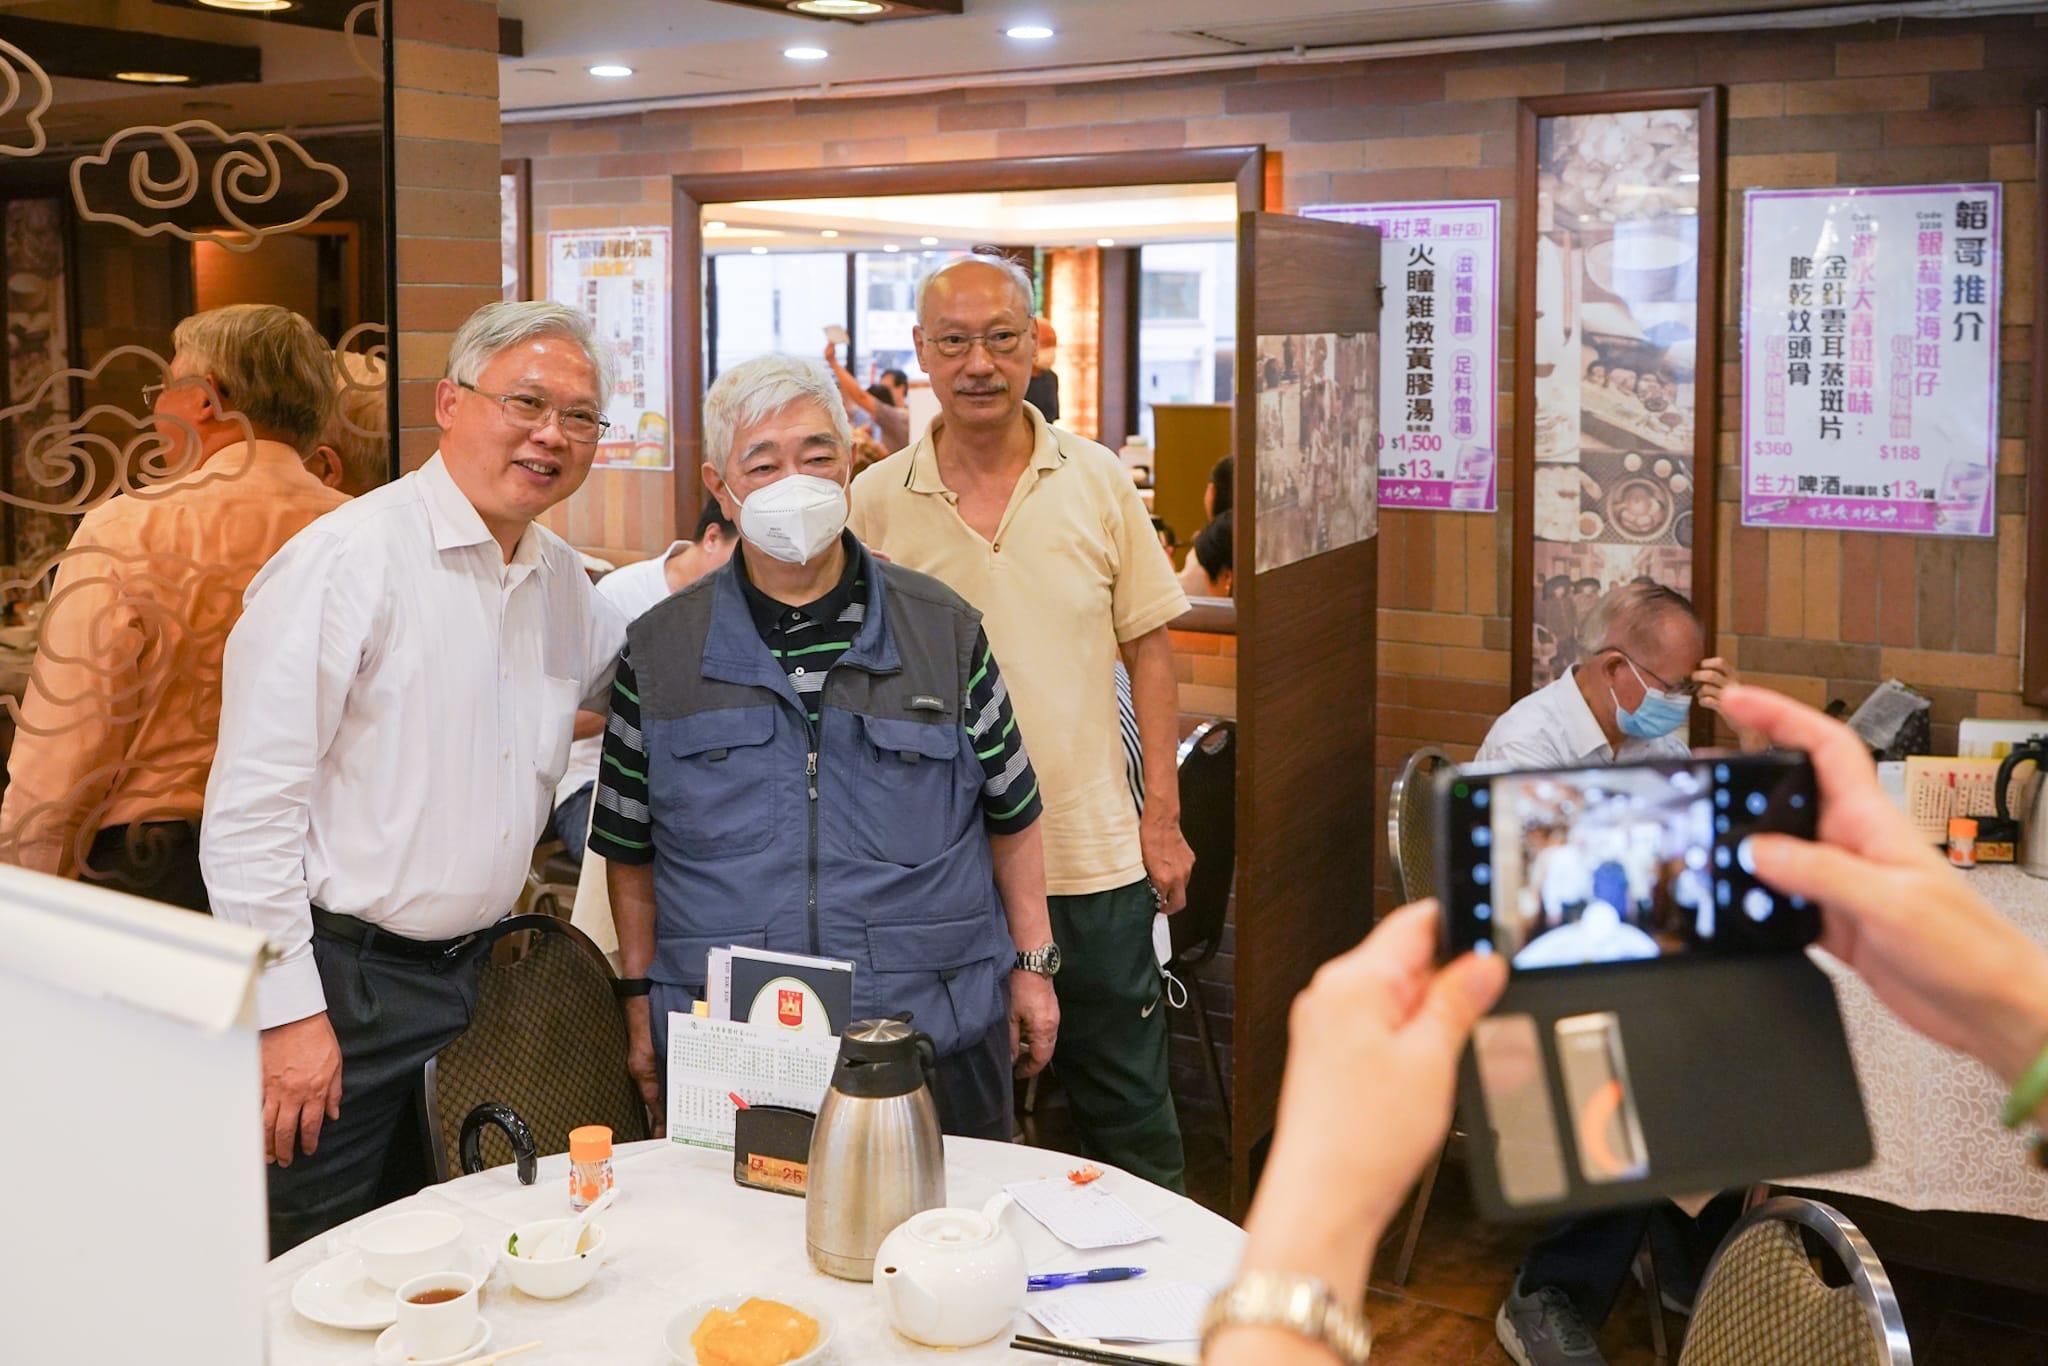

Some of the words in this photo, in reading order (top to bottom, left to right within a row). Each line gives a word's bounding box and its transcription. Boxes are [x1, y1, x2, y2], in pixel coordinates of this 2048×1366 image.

[1391, 434, 1442, 453] $1,500
[1754, 442, 1792, 457] $360
[1880, 446, 1920, 461] $188
[782, 1166, 803, 1185] 25
